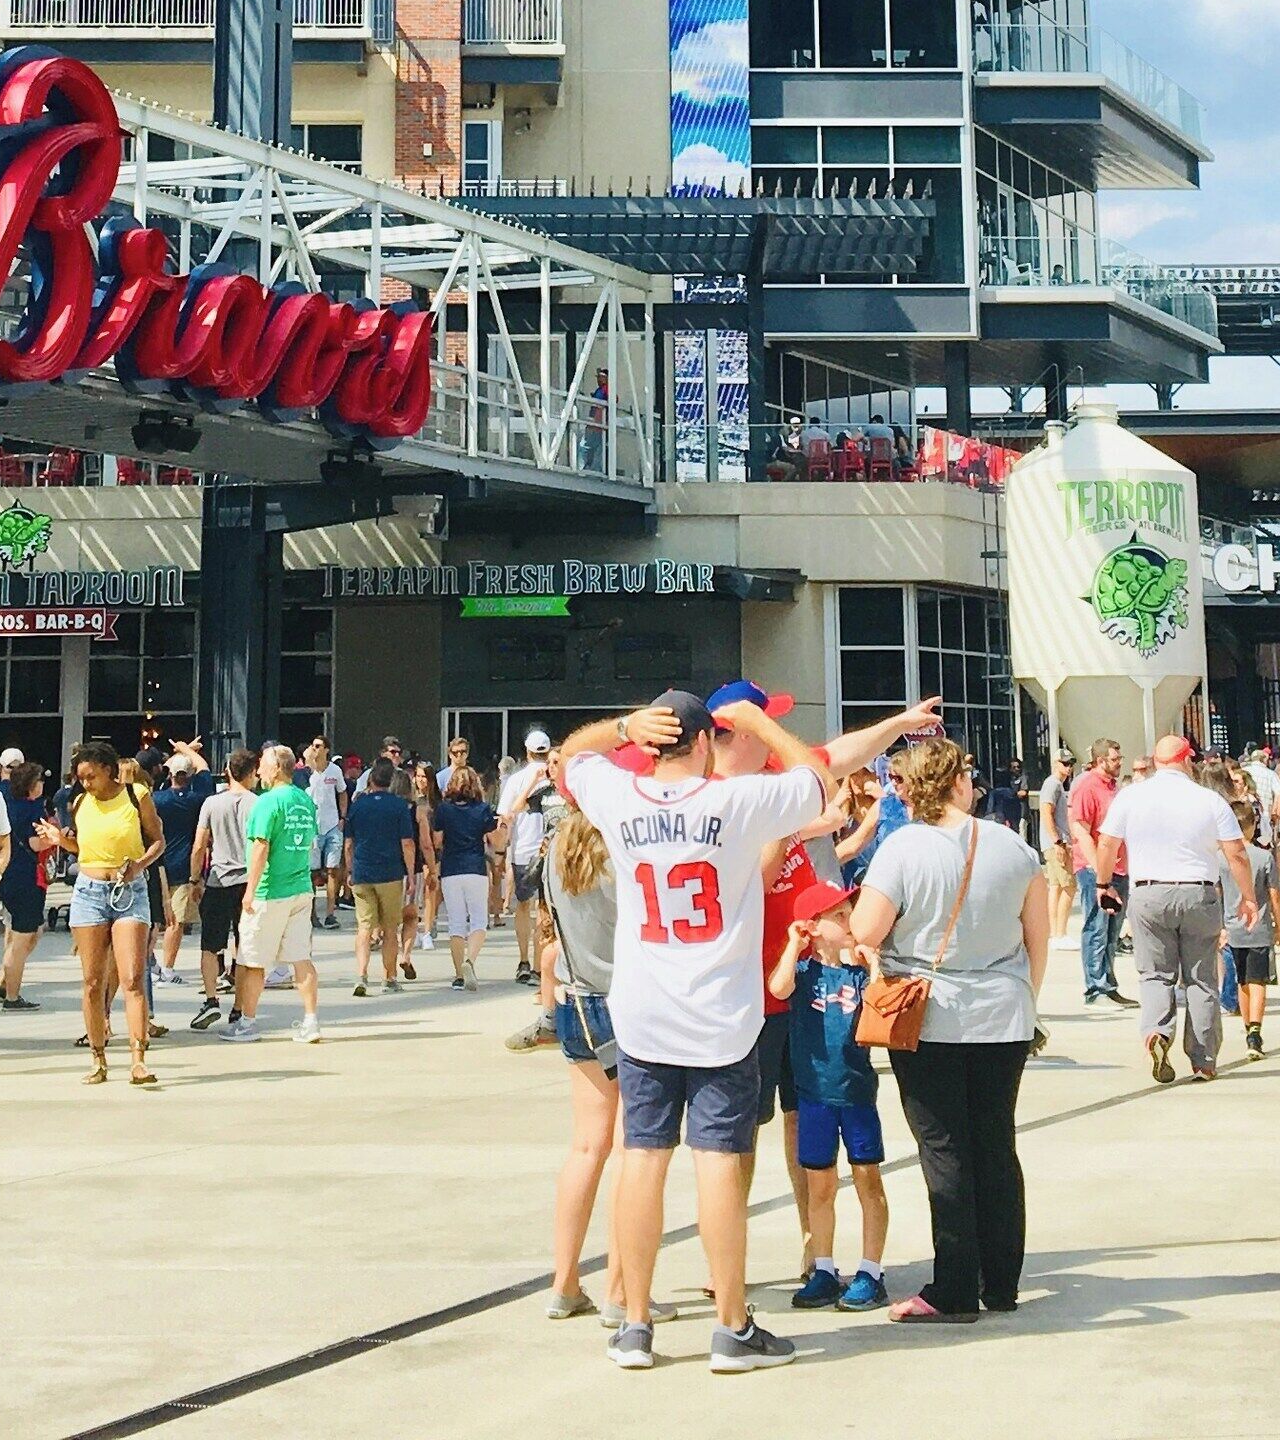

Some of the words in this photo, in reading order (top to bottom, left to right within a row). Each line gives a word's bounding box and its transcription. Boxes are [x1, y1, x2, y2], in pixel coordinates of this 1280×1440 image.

[1056, 478, 1188, 542] TERRAPIN
[22, 564, 185, 607] TAPROOM
[321, 563, 460, 598] TERRAPIN
[467, 559, 555, 596] FRESH
[562, 558, 649, 595] BREW
[654, 558, 716, 594] BAR
[35, 612, 103, 631] BAR-B-Q
[620, 809, 686, 850] ACUÑA
[693, 814, 722, 848] JR.
[634, 860, 724, 945] 13
